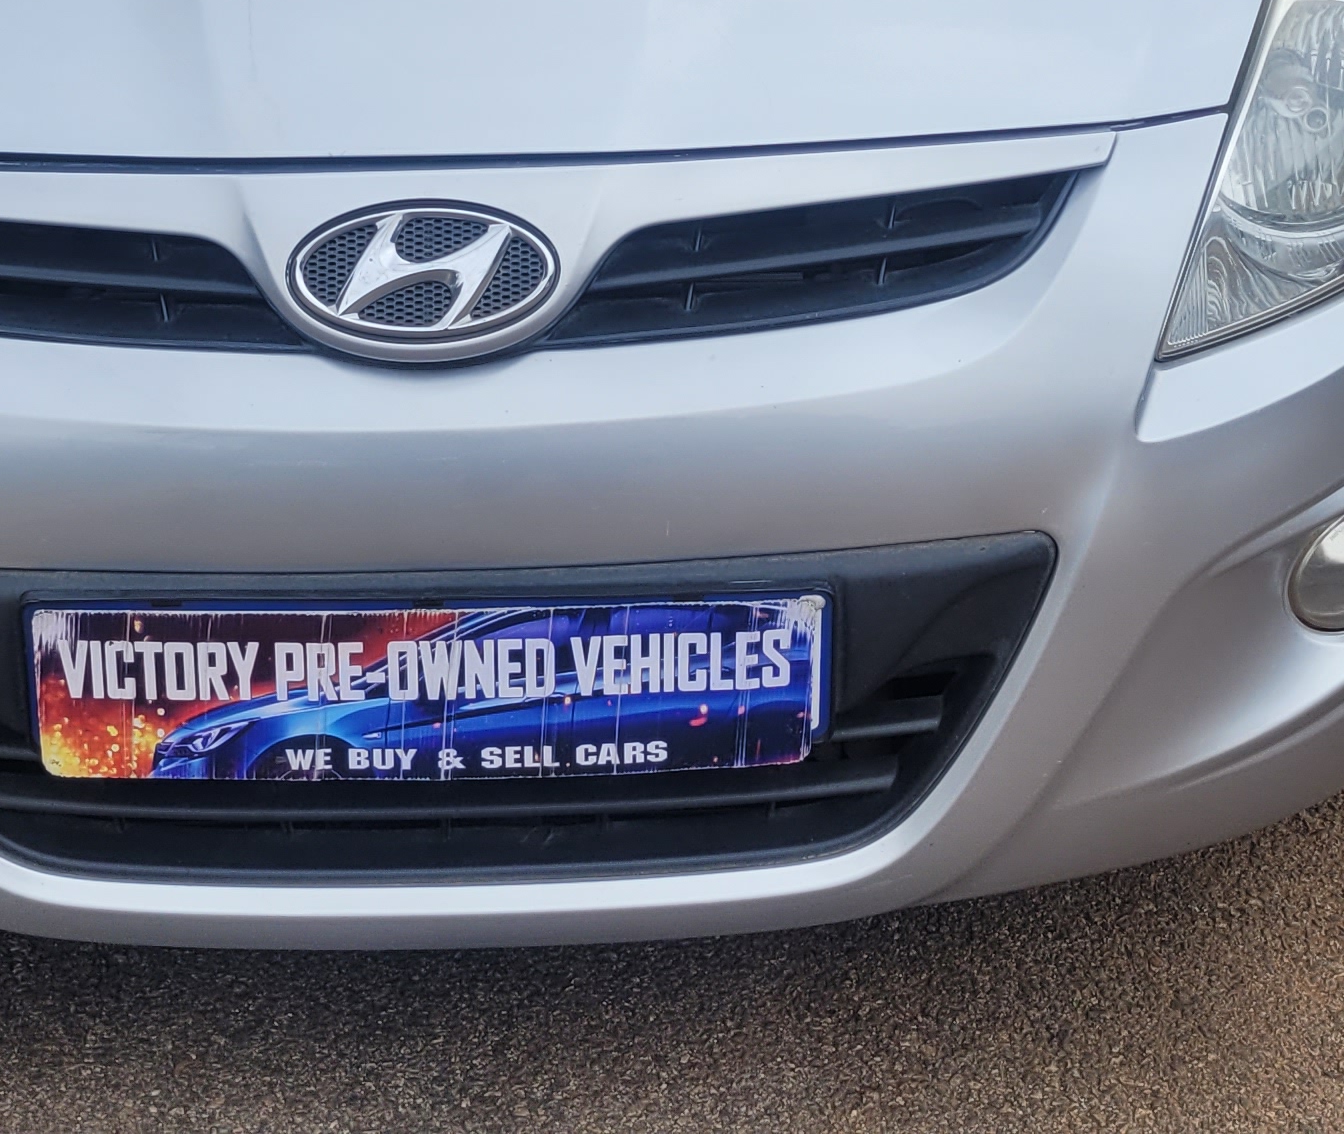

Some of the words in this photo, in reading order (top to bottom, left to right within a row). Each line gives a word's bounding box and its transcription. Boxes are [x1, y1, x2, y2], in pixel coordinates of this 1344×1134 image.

[57, 640, 259, 701] VICTORY
[274, 637, 555, 702] PRE-OWNED
[570, 629, 792, 697] VEHICLES
[285, 747, 333, 771] WE
[348, 748, 418, 771] BUY
[437, 748, 466, 770] &
[481, 744, 561, 769] SELL
[575, 740, 668, 766] CARS
